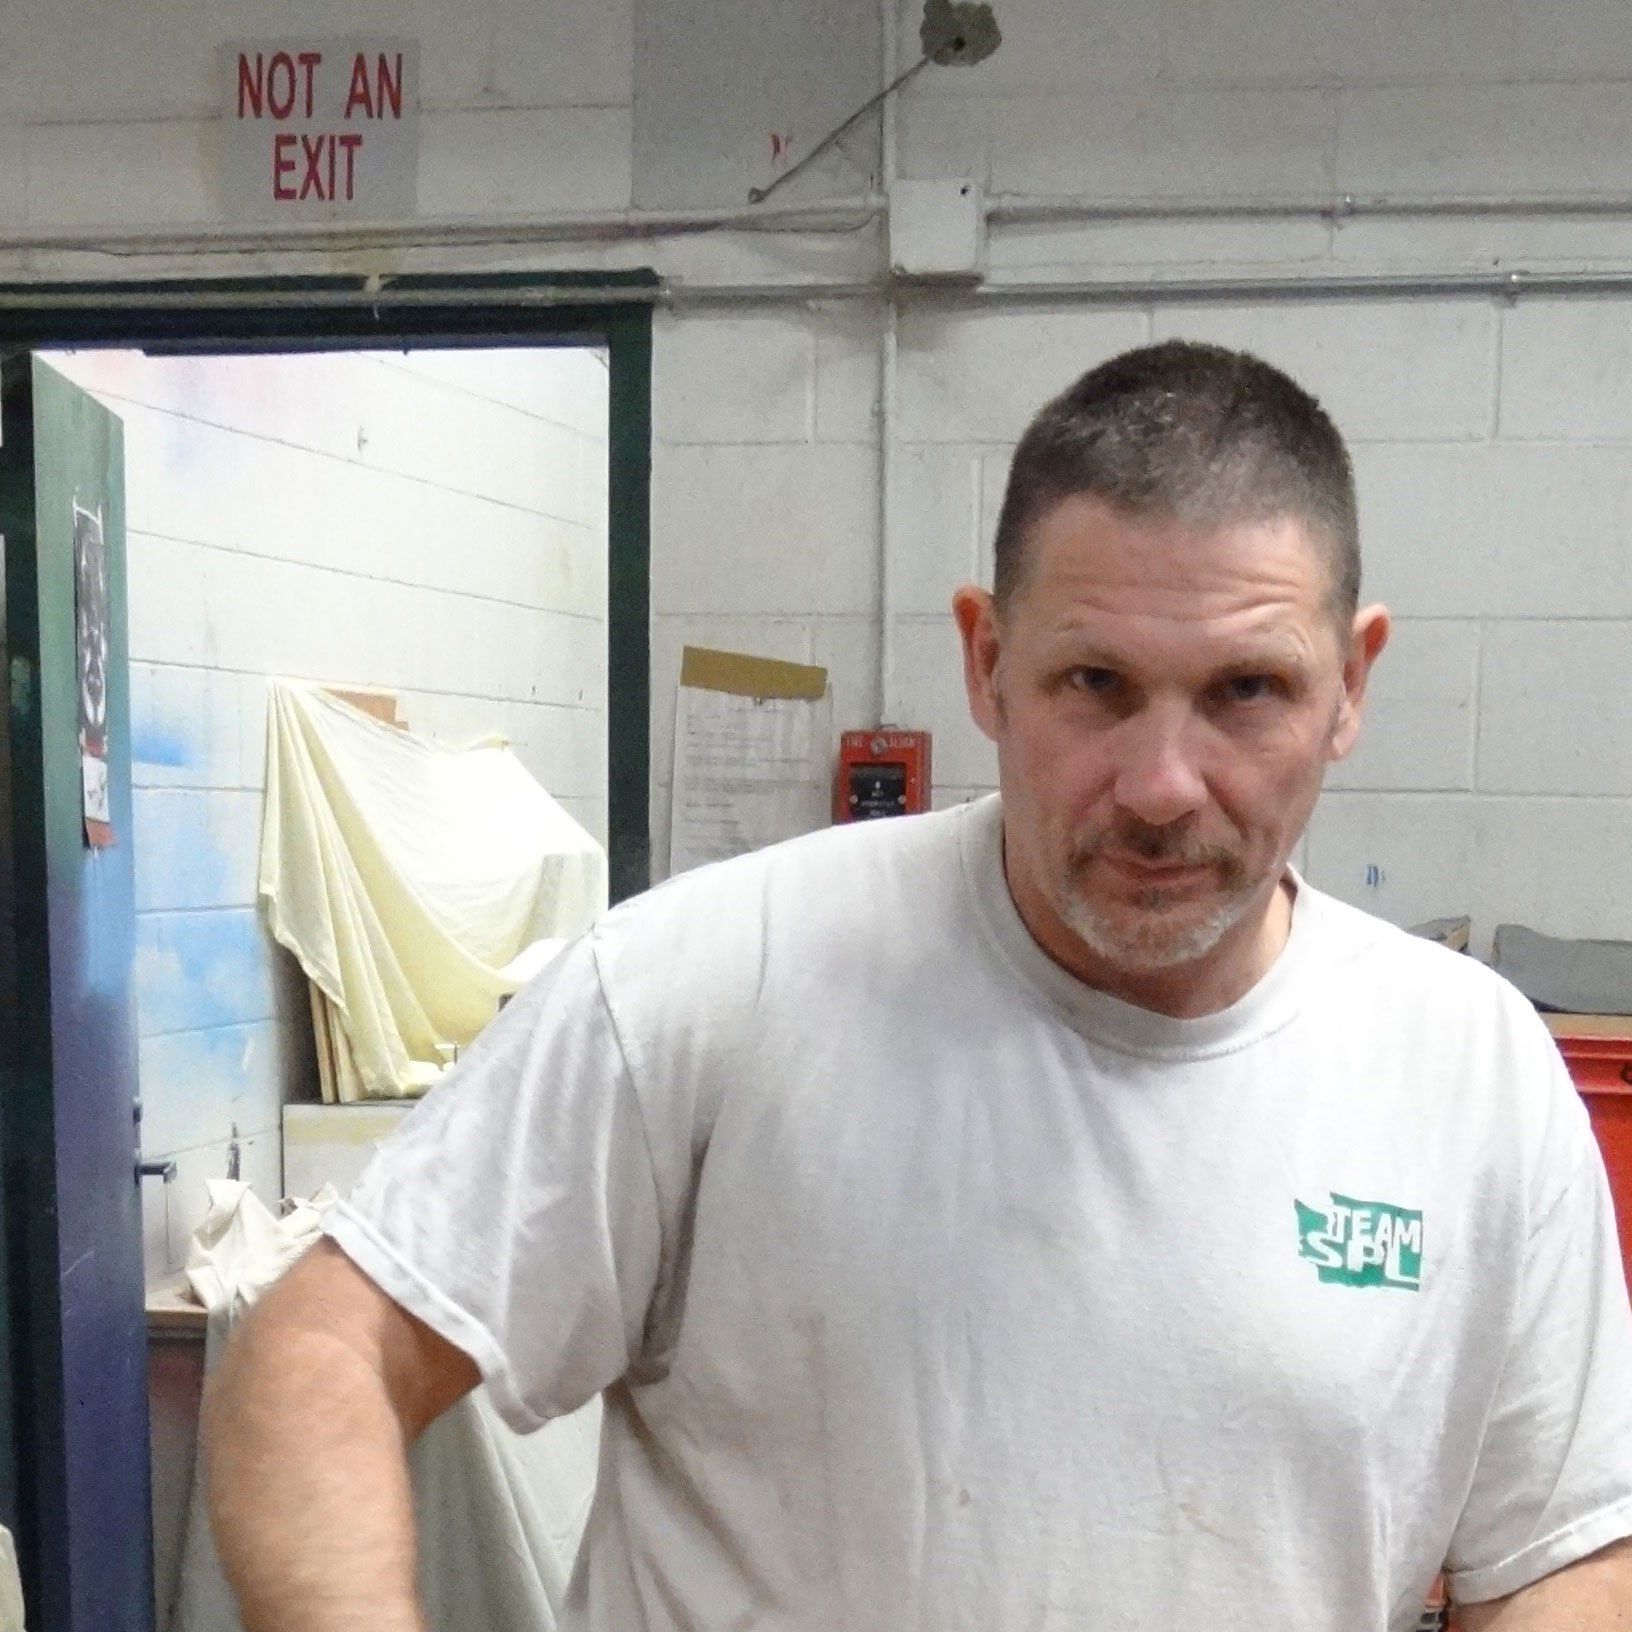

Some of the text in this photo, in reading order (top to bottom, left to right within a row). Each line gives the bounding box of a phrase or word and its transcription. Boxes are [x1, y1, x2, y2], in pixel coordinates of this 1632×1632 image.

[237, 51, 403, 120] NOT AN
[273, 134, 363, 200] EXIT
